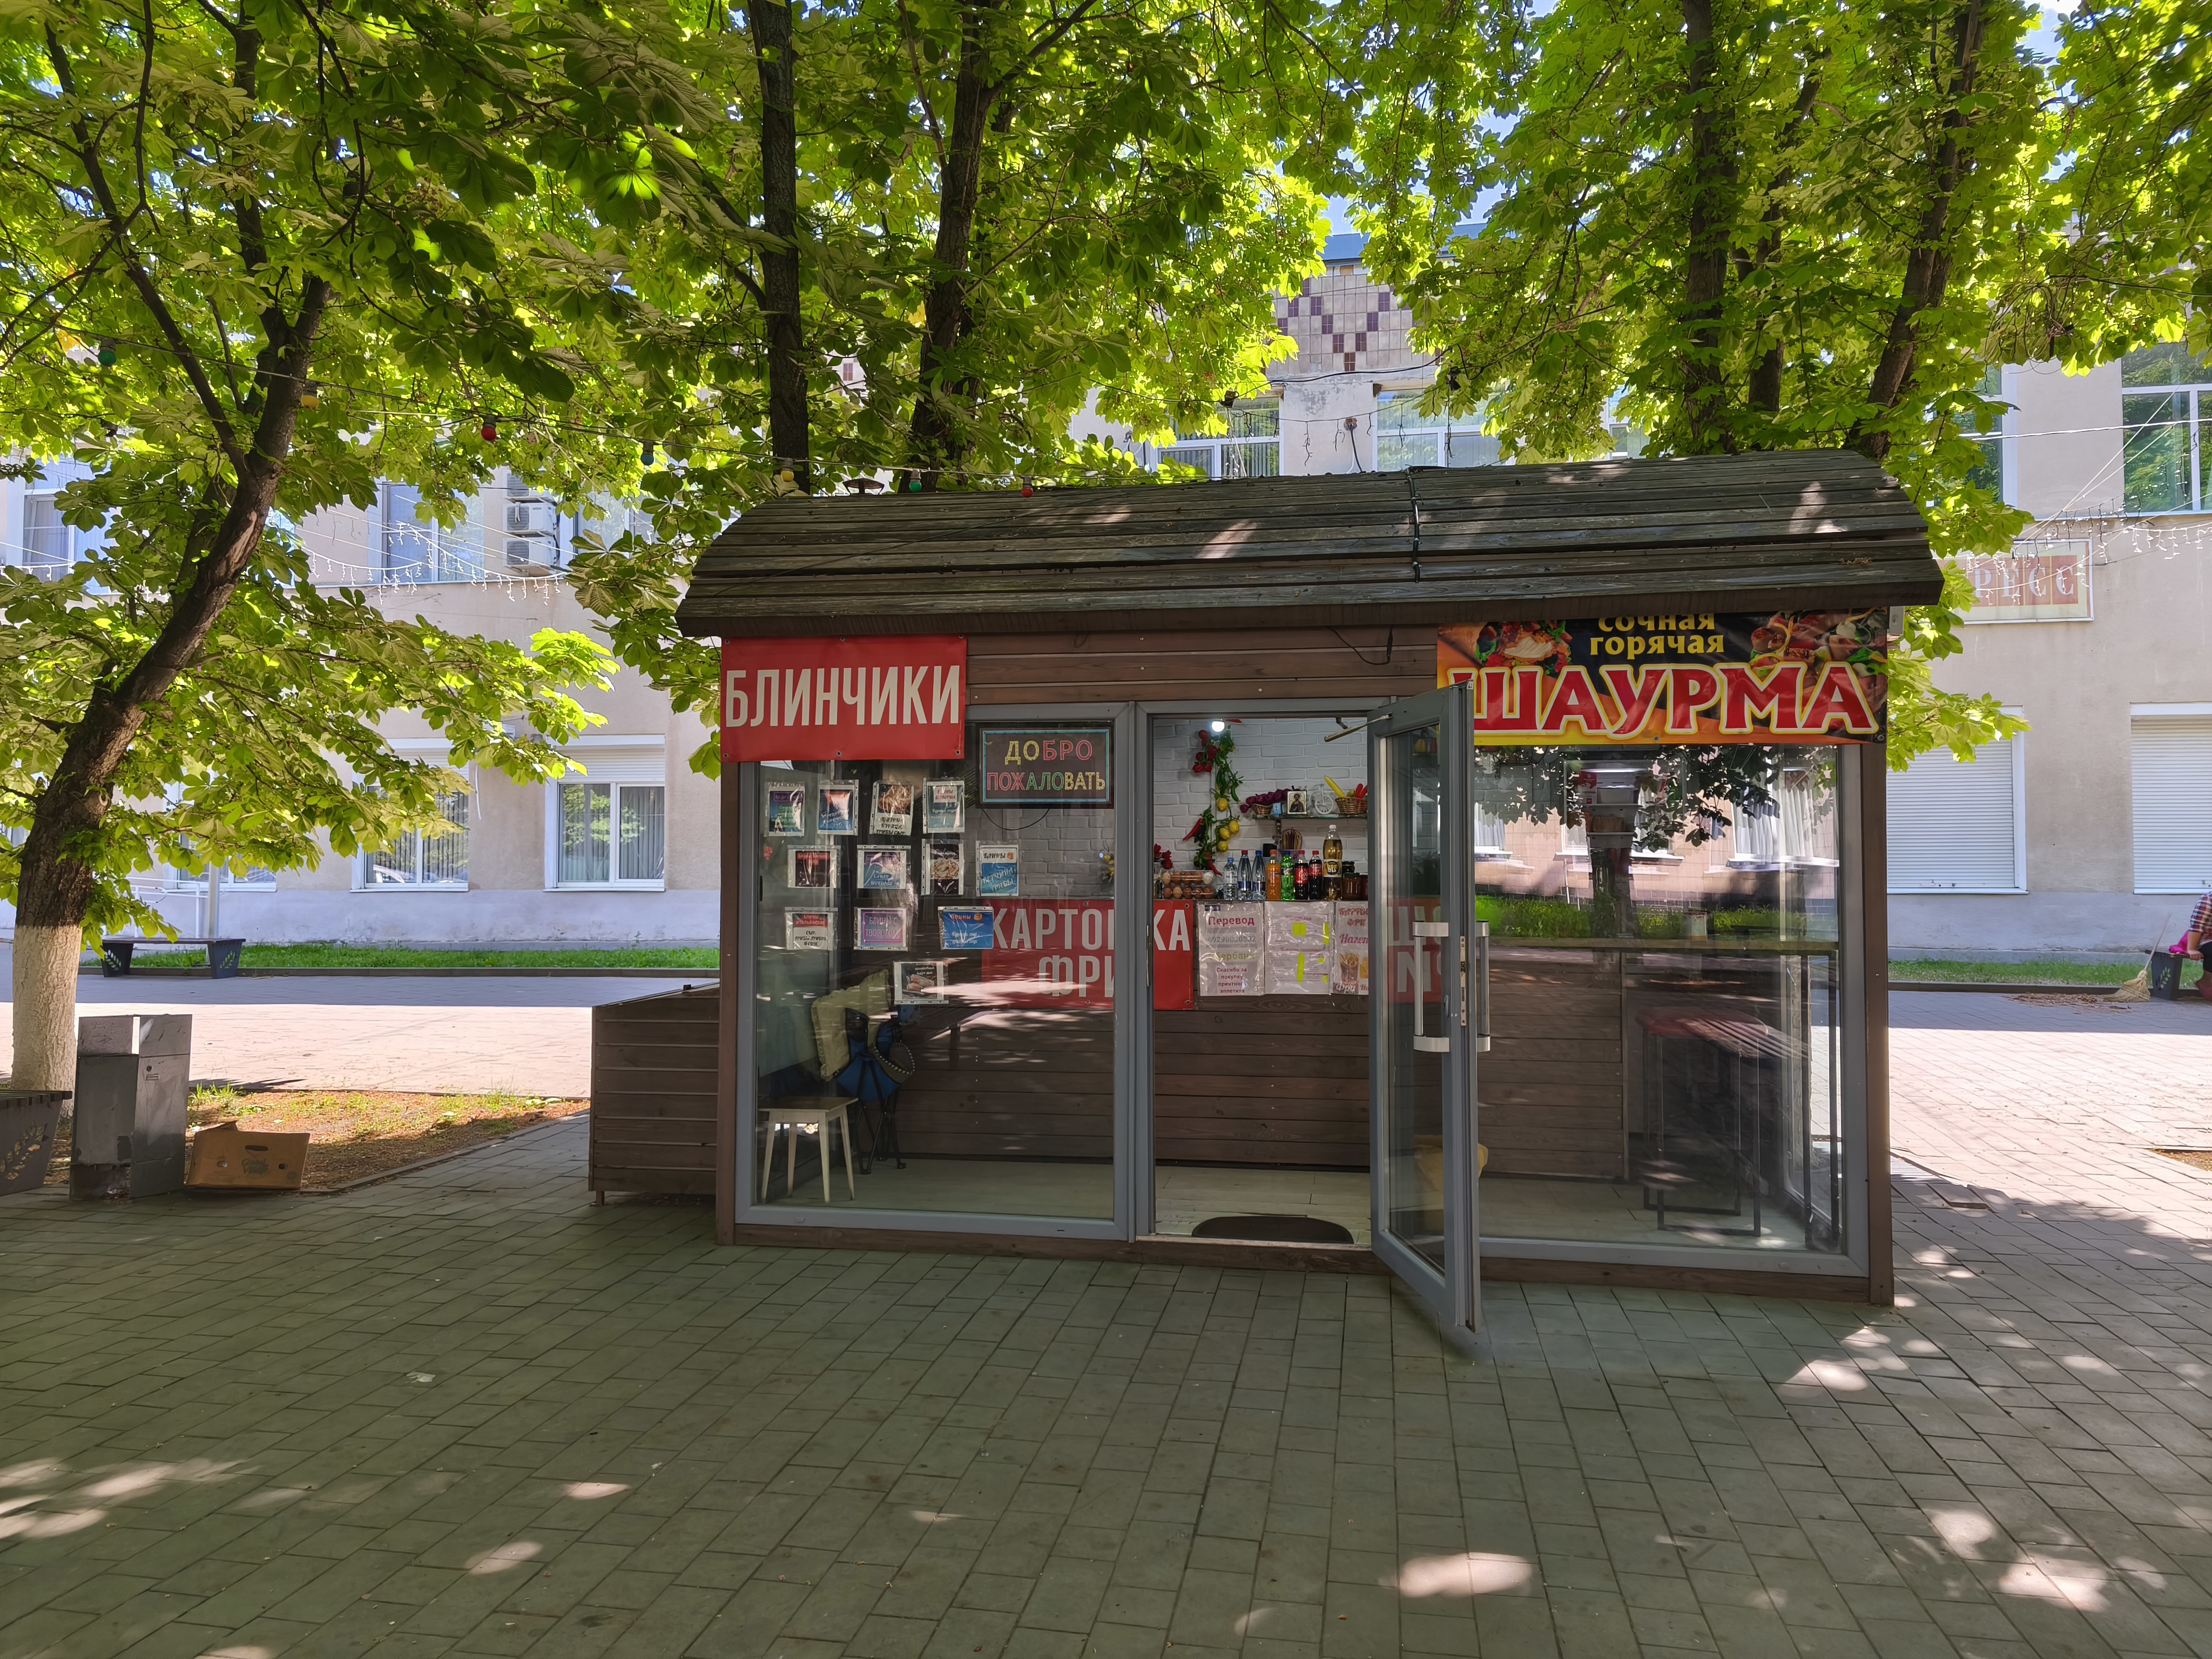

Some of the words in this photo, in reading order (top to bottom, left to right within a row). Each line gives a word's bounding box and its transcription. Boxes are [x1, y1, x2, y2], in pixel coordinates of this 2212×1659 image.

[1974, 565, 2074, 598] РЕСС
[1599, 612, 1715, 632] сочная
[1590, 635, 1724, 659] горячая
[725, 665, 960, 727] БЛИНЧИКИ
[1449, 663, 1878, 739] ШАУРМА
[1004, 740, 1092, 766] ДОБРО
[987, 772, 1105, 791] ПОЖАЛОВАТЬ
[993, 908, 1190, 951] КАРТОКА
[1209, 916, 1255, 927] Перевод
